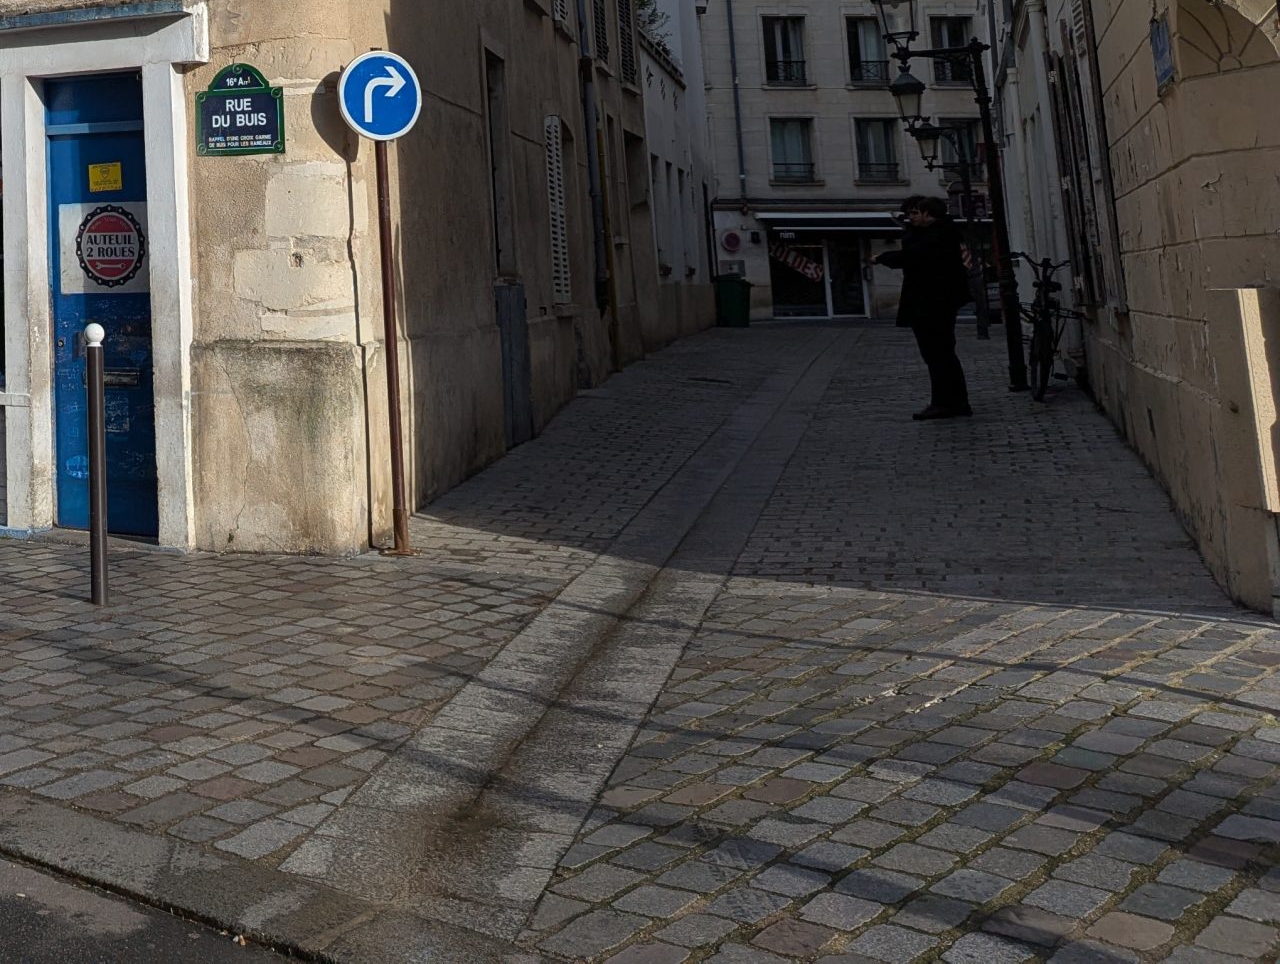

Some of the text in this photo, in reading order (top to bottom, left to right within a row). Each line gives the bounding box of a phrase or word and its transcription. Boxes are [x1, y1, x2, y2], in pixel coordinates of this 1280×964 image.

[225, 98, 252, 112] RUE
[212, 112, 267, 128] DU BUIS
[86, 234, 135, 245] AUTEUIL
[86, 246, 135, 258] 2 ROUES
